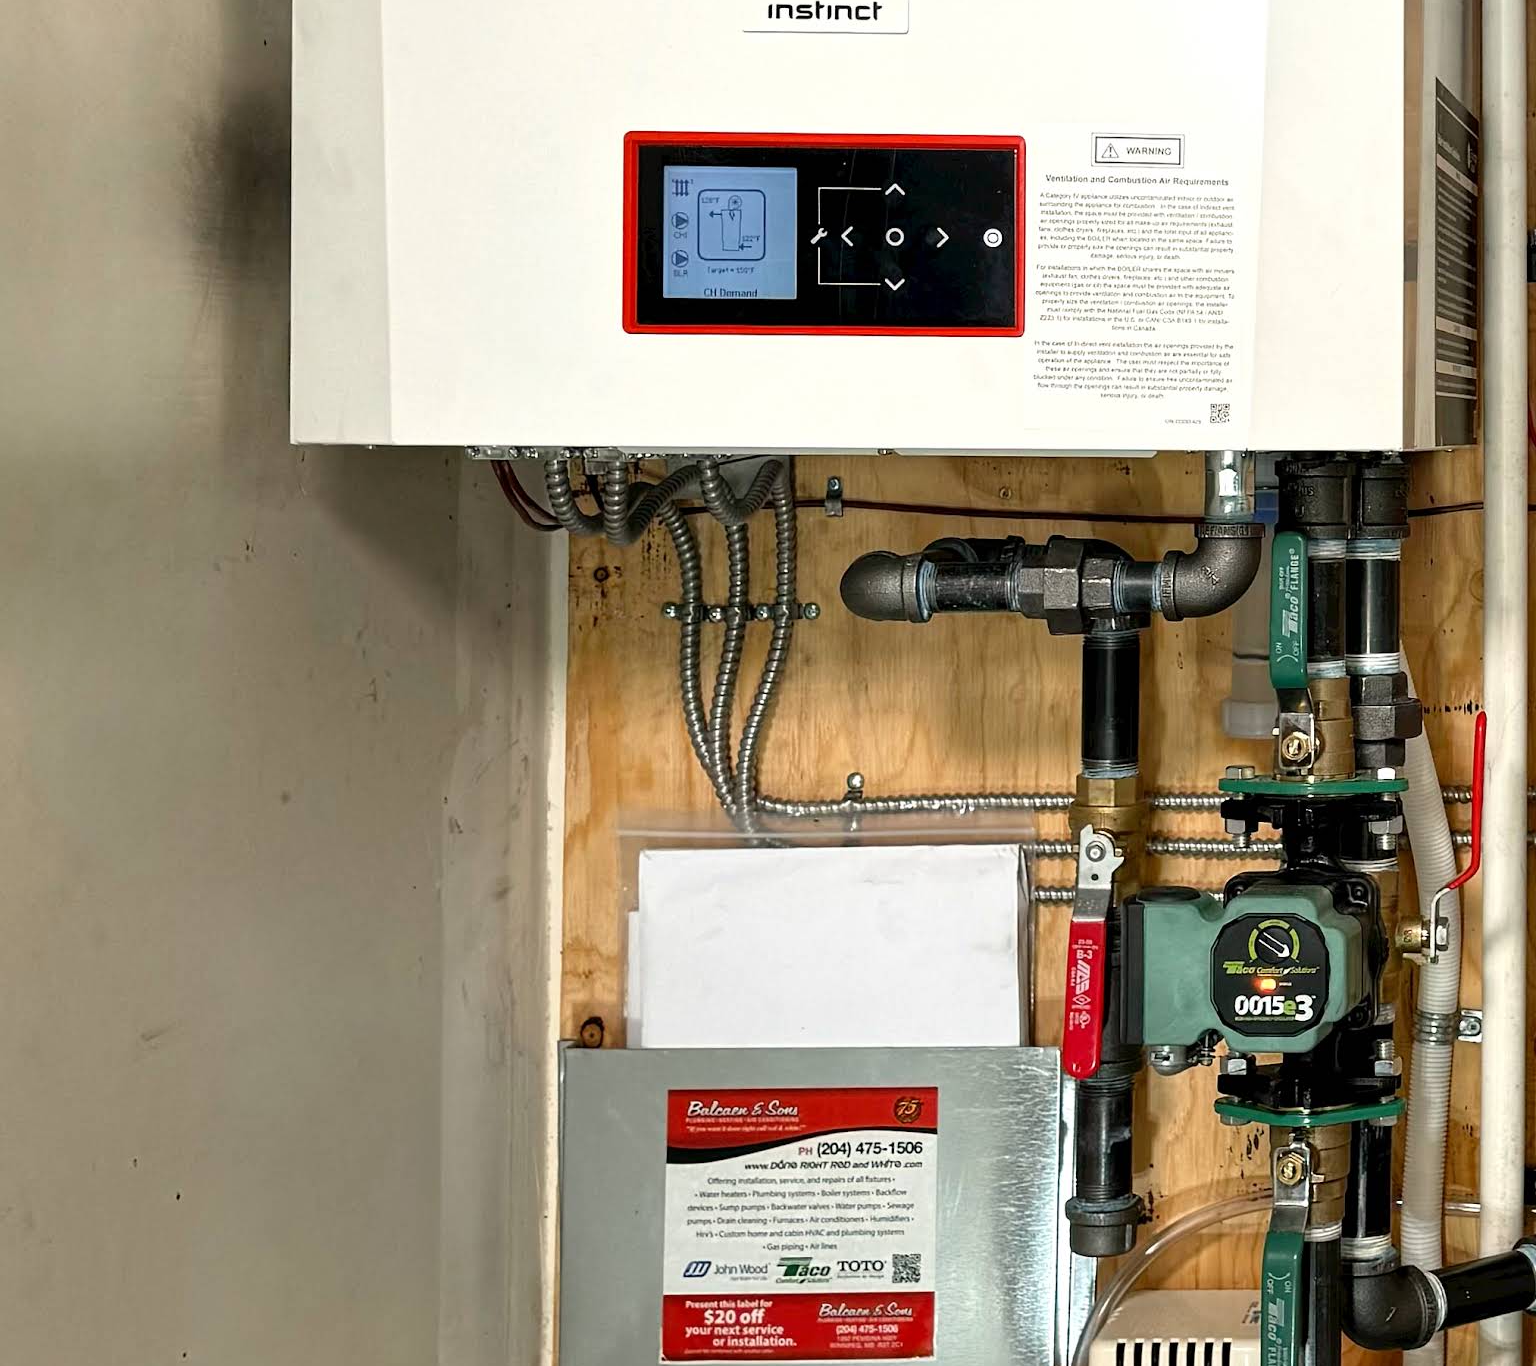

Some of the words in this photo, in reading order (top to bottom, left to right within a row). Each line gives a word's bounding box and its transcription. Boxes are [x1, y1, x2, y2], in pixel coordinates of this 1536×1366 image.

[768, 0, 883, 22] instinct
[1126, 147, 1172, 156] WARNING
[1046, 174, 1089, 184] Ventilation
[1090, 175, 1106, 185] and
[1108, 175, 1158, 185] Combustion
[1159, 177, 1172, 185] Air
[1173, 178, 1229, 187] Requirements
[704, 288, 718, 298] CH
[720, 288, 758, 298] Demand
[1275, 642, 1283, 655] ON
[687, 1100, 749, 1116] Balcaen
[751, 1101, 765, 1116] &
[765, 1100, 798, 1116] Sons
[897, 1100, 921, 1116] 75
[798, 1147, 813, 1156] PH
[817, 1142, 851, 1158] (204)
[855, 1141, 923, 1155] 475-1506
[853, 1161, 869, 1169] and
[708, 1178, 737, 1186] Offering
[822, 1177, 846, 1185] repairs
[753, 1190, 787, 1198] Plumbing
[843, 1190, 870, 1198] systems
[719, 1204, 740, 1212] Sump
[857, 1203, 881, 1211] pumps
[887, 1202, 915, 1210] Sewage
[738, 1217, 768, 1225] cleaning
[784, 1229, 804, 1237] cabin
[841, 1229, 876, 1237] plumbing
[781, 1243, 805, 1251] piping
[714, 1264, 737, 1275] John
[739, 1264, 769, 1275] Wood
[777, 1257, 831, 1277] Taco
[837, 1260, 884, 1272] TOTO
[1284, 1280, 1292, 1294] ON
[685, 1300, 718, 1309] Present
[720, 1300, 736, 1308] this
[737, 1299, 759, 1308] label
[760, 1299, 774, 1308] for
[819, 1303, 870, 1317] Balcaen
[885, 1302, 913, 1316] Sons
[704, 1309, 737, 1325] $20
[740, 1308, 766, 1324] off
[685, 1326, 712, 1338] your
[714, 1325, 741, 1335] next
[742, 1324, 785, 1335] service
[836, 1324, 857, 1335] (204)
[713, 1338, 726, 1347] or
[727, 1336, 798, 1347] installation.
